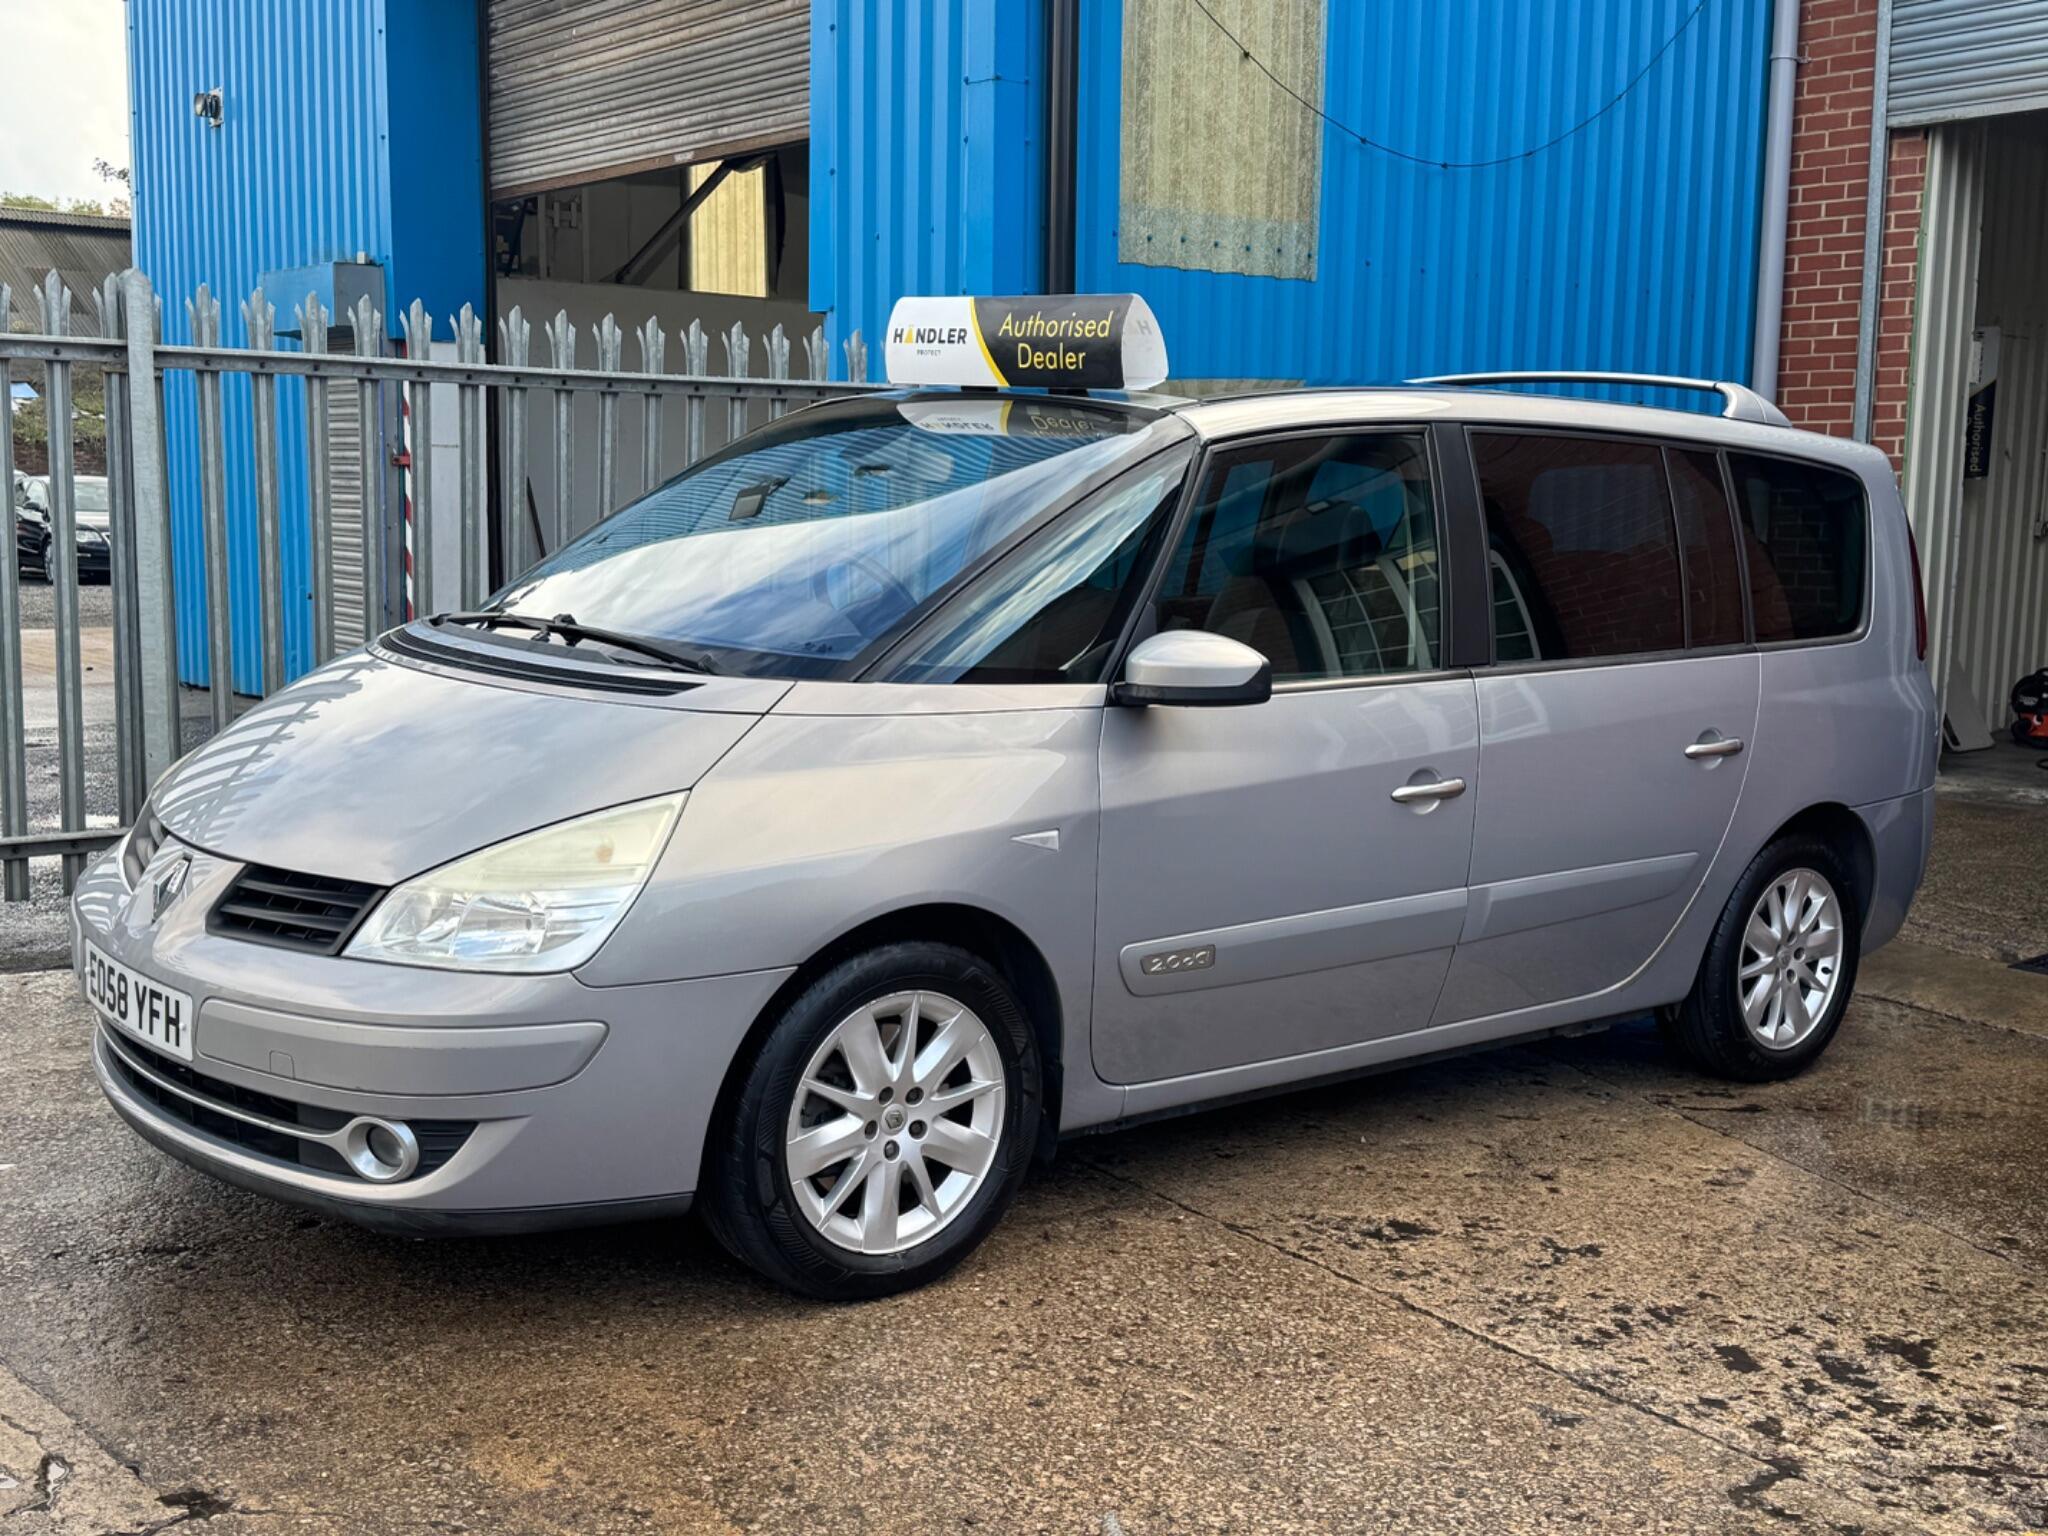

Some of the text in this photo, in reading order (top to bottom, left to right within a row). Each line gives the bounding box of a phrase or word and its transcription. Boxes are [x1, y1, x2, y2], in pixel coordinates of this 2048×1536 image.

[893, 326, 967, 344] HANDLER
[998, 311, 1113, 338] Authorised
[1017, 343, 1086, 370] Dealer
[1969, 403, 1987, 473] Authorised
[134, 980, 181, 1048] YFH
